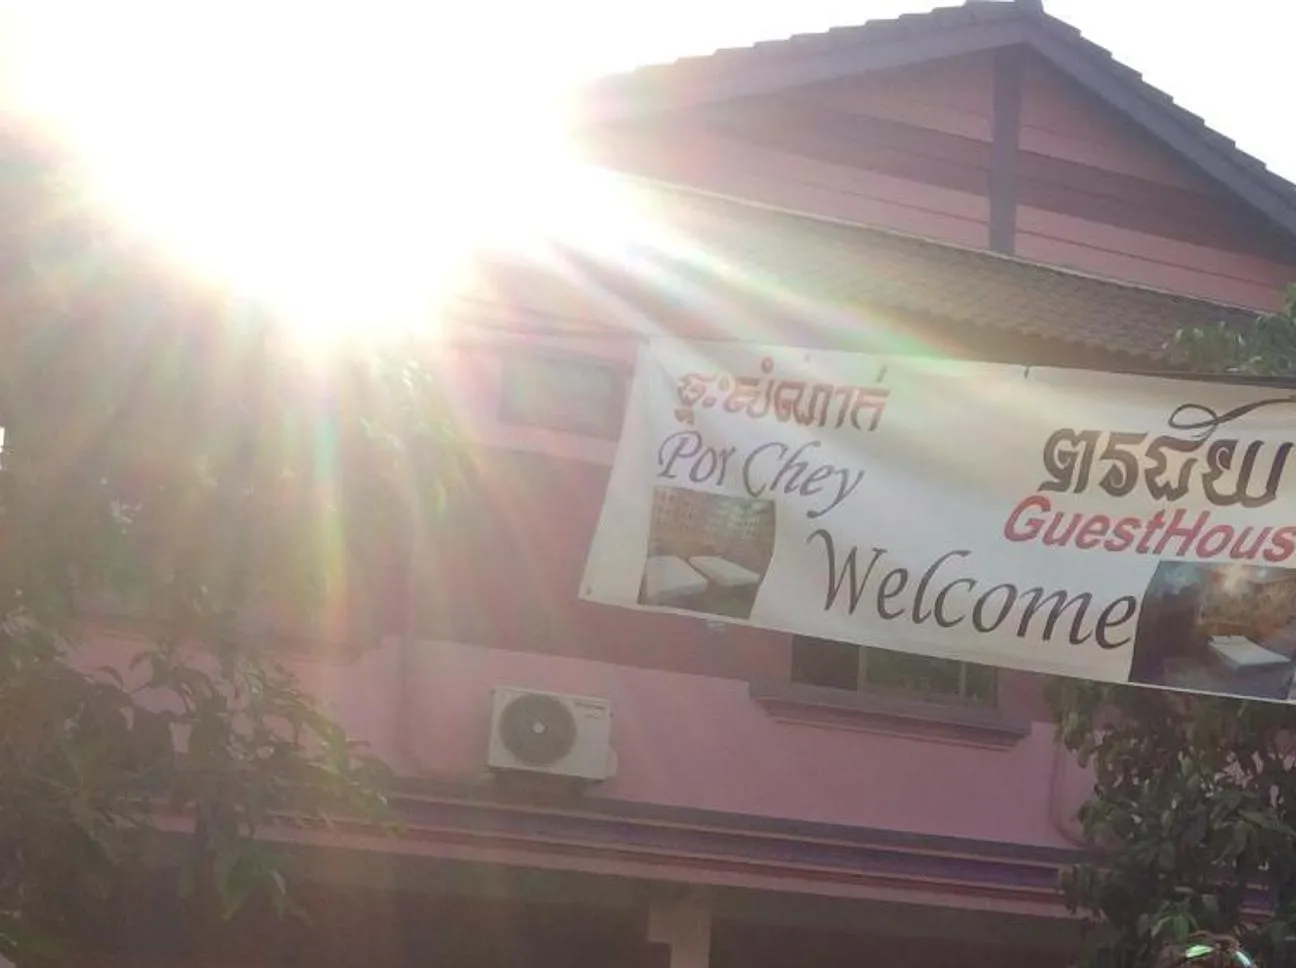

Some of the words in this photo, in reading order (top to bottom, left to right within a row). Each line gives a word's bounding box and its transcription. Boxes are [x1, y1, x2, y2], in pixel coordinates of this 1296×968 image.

[656, 429, 736, 486] Por
[742, 440, 866, 518] Chey
[806, 528, 1138, 650] Welcome
